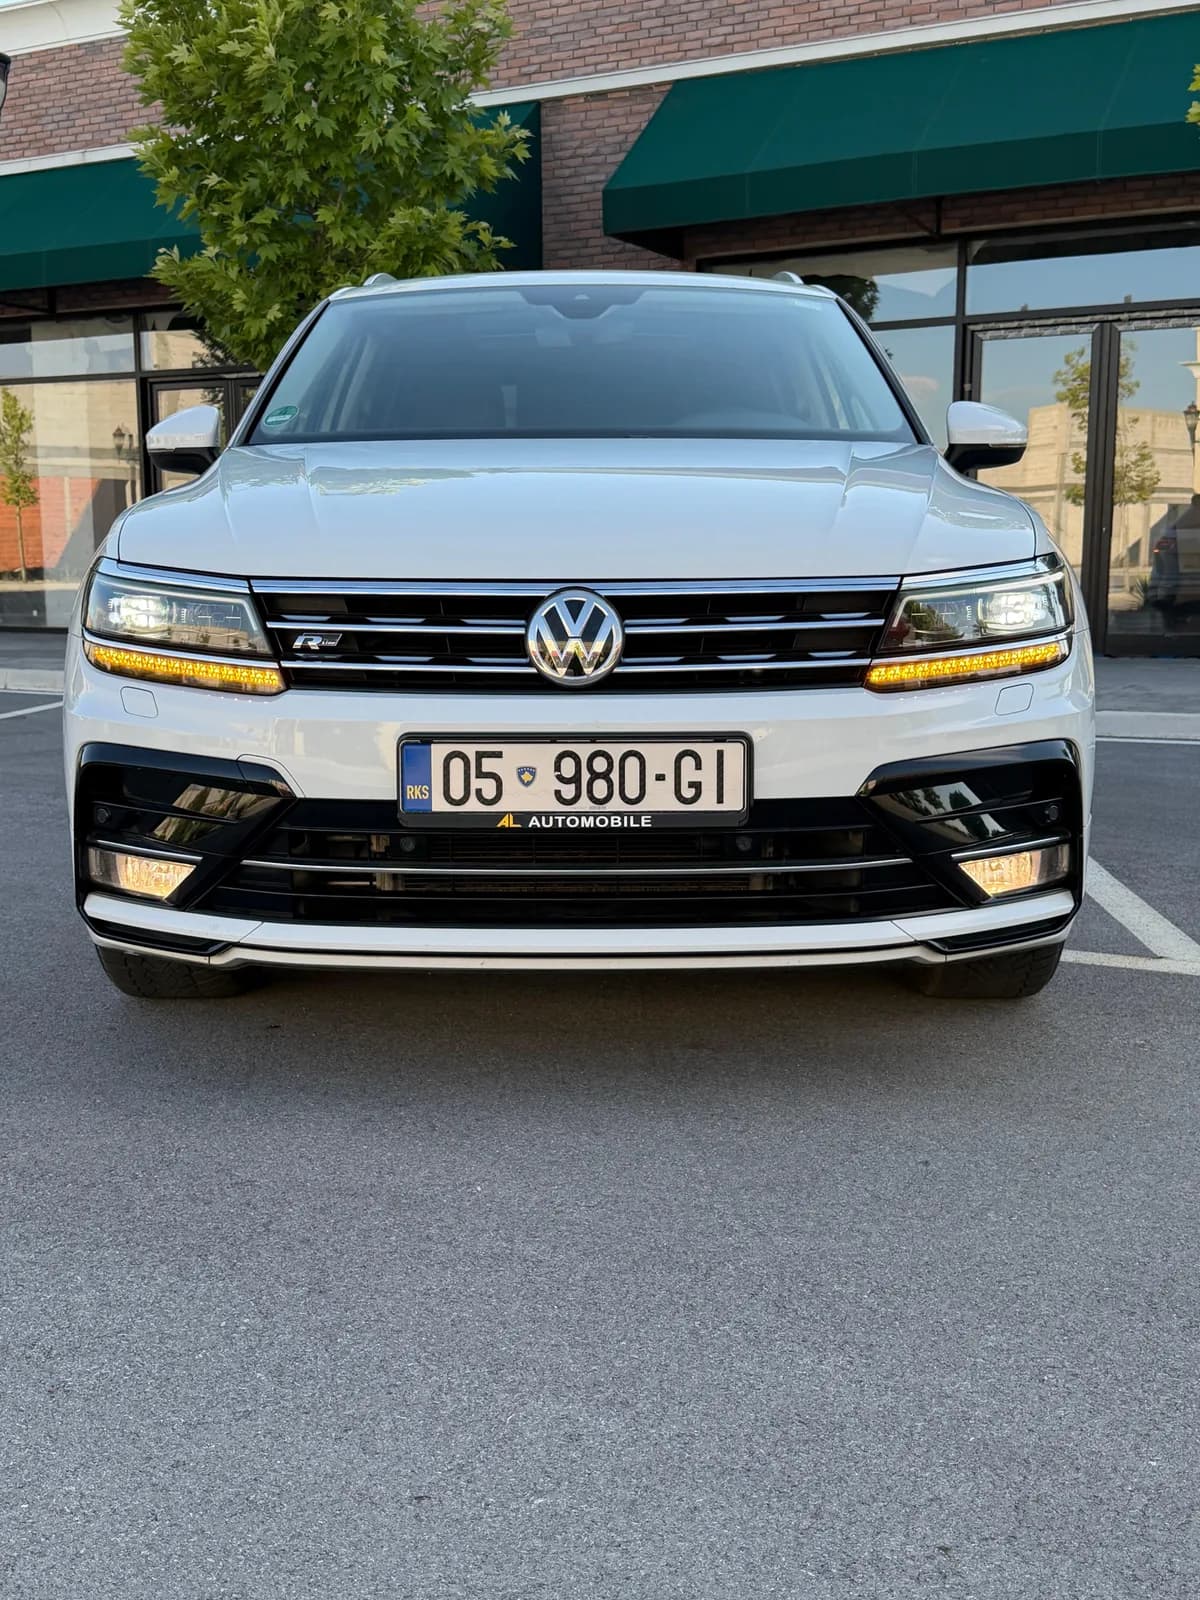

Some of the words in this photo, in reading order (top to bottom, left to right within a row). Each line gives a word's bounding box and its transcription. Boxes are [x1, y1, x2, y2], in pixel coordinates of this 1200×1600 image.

[529, 591, 620, 684] VW
[406, 785, 429, 800] RKS
[443, 750, 504, 806] 05
[554, 750, 724, 806] 980-GI
[496, 813, 522, 828] AL
[528, 815, 652, 828] AUTOMOBILE
